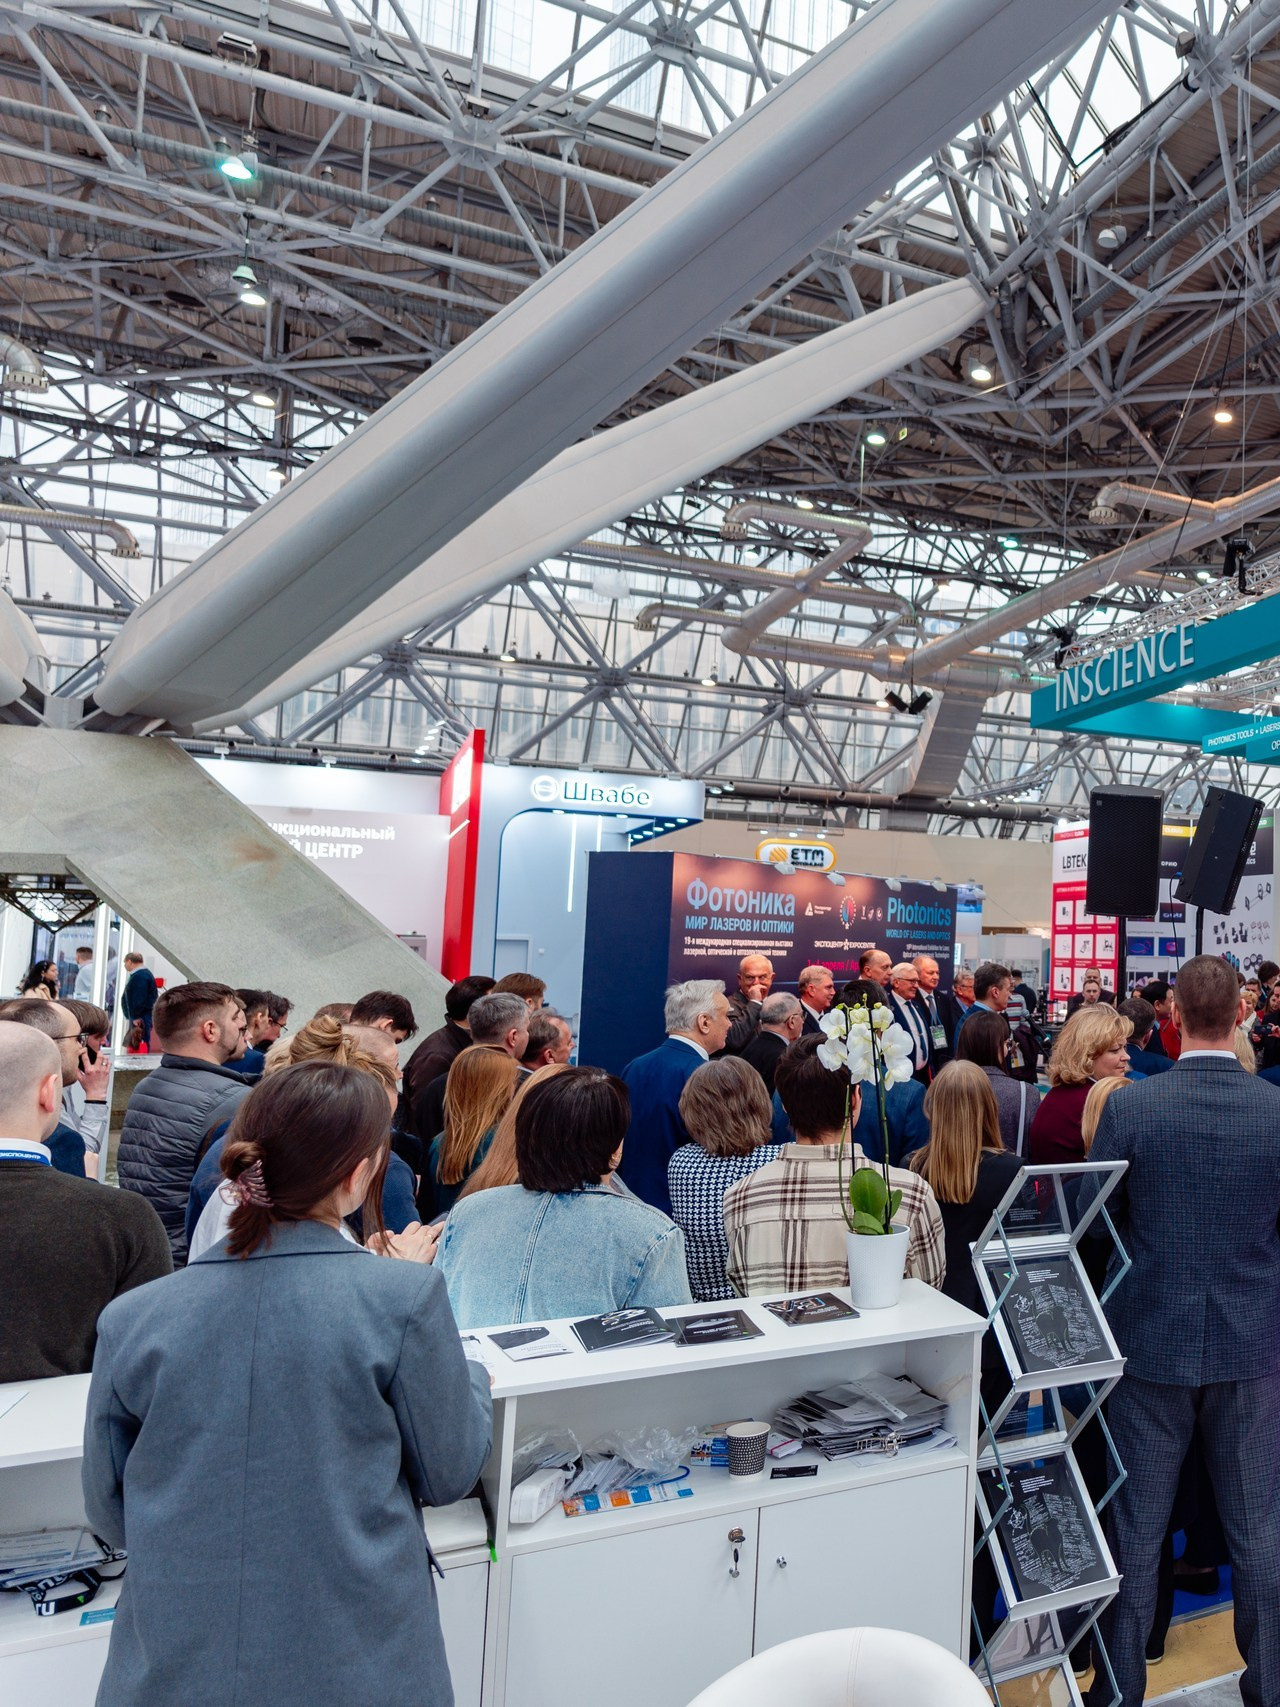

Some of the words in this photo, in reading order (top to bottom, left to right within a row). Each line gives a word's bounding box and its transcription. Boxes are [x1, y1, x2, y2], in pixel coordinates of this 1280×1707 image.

[1055, 620, 1195, 711] INSCIENCE
[1208, 733, 1236, 747] PHOTONICS
[1237, 728, 1254, 739] TOOLS
[1260, 722, 1280, 734] LASERS
[562, 780, 651, 807] Швабе
[267, 822, 396, 841] нкциональный
[304, 841, 364, 859] ЦЕНТР
[1062, 853, 1087, 869] LBTEK
[686, 877, 796, 916] Фотоника
[887, 896, 951, 927] Photonics
[685, 915, 708, 930] МИР
[710, 917, 752, 932] ЛАЗЕРОВ
[753, 919, 760, 932] И
[761, 920, 795, 934] ОПТИКИ
[885, 929, 903, 938] WORLD
[903, 929, 910, 939] OF
[910, 930, 926, 939] LASERS
